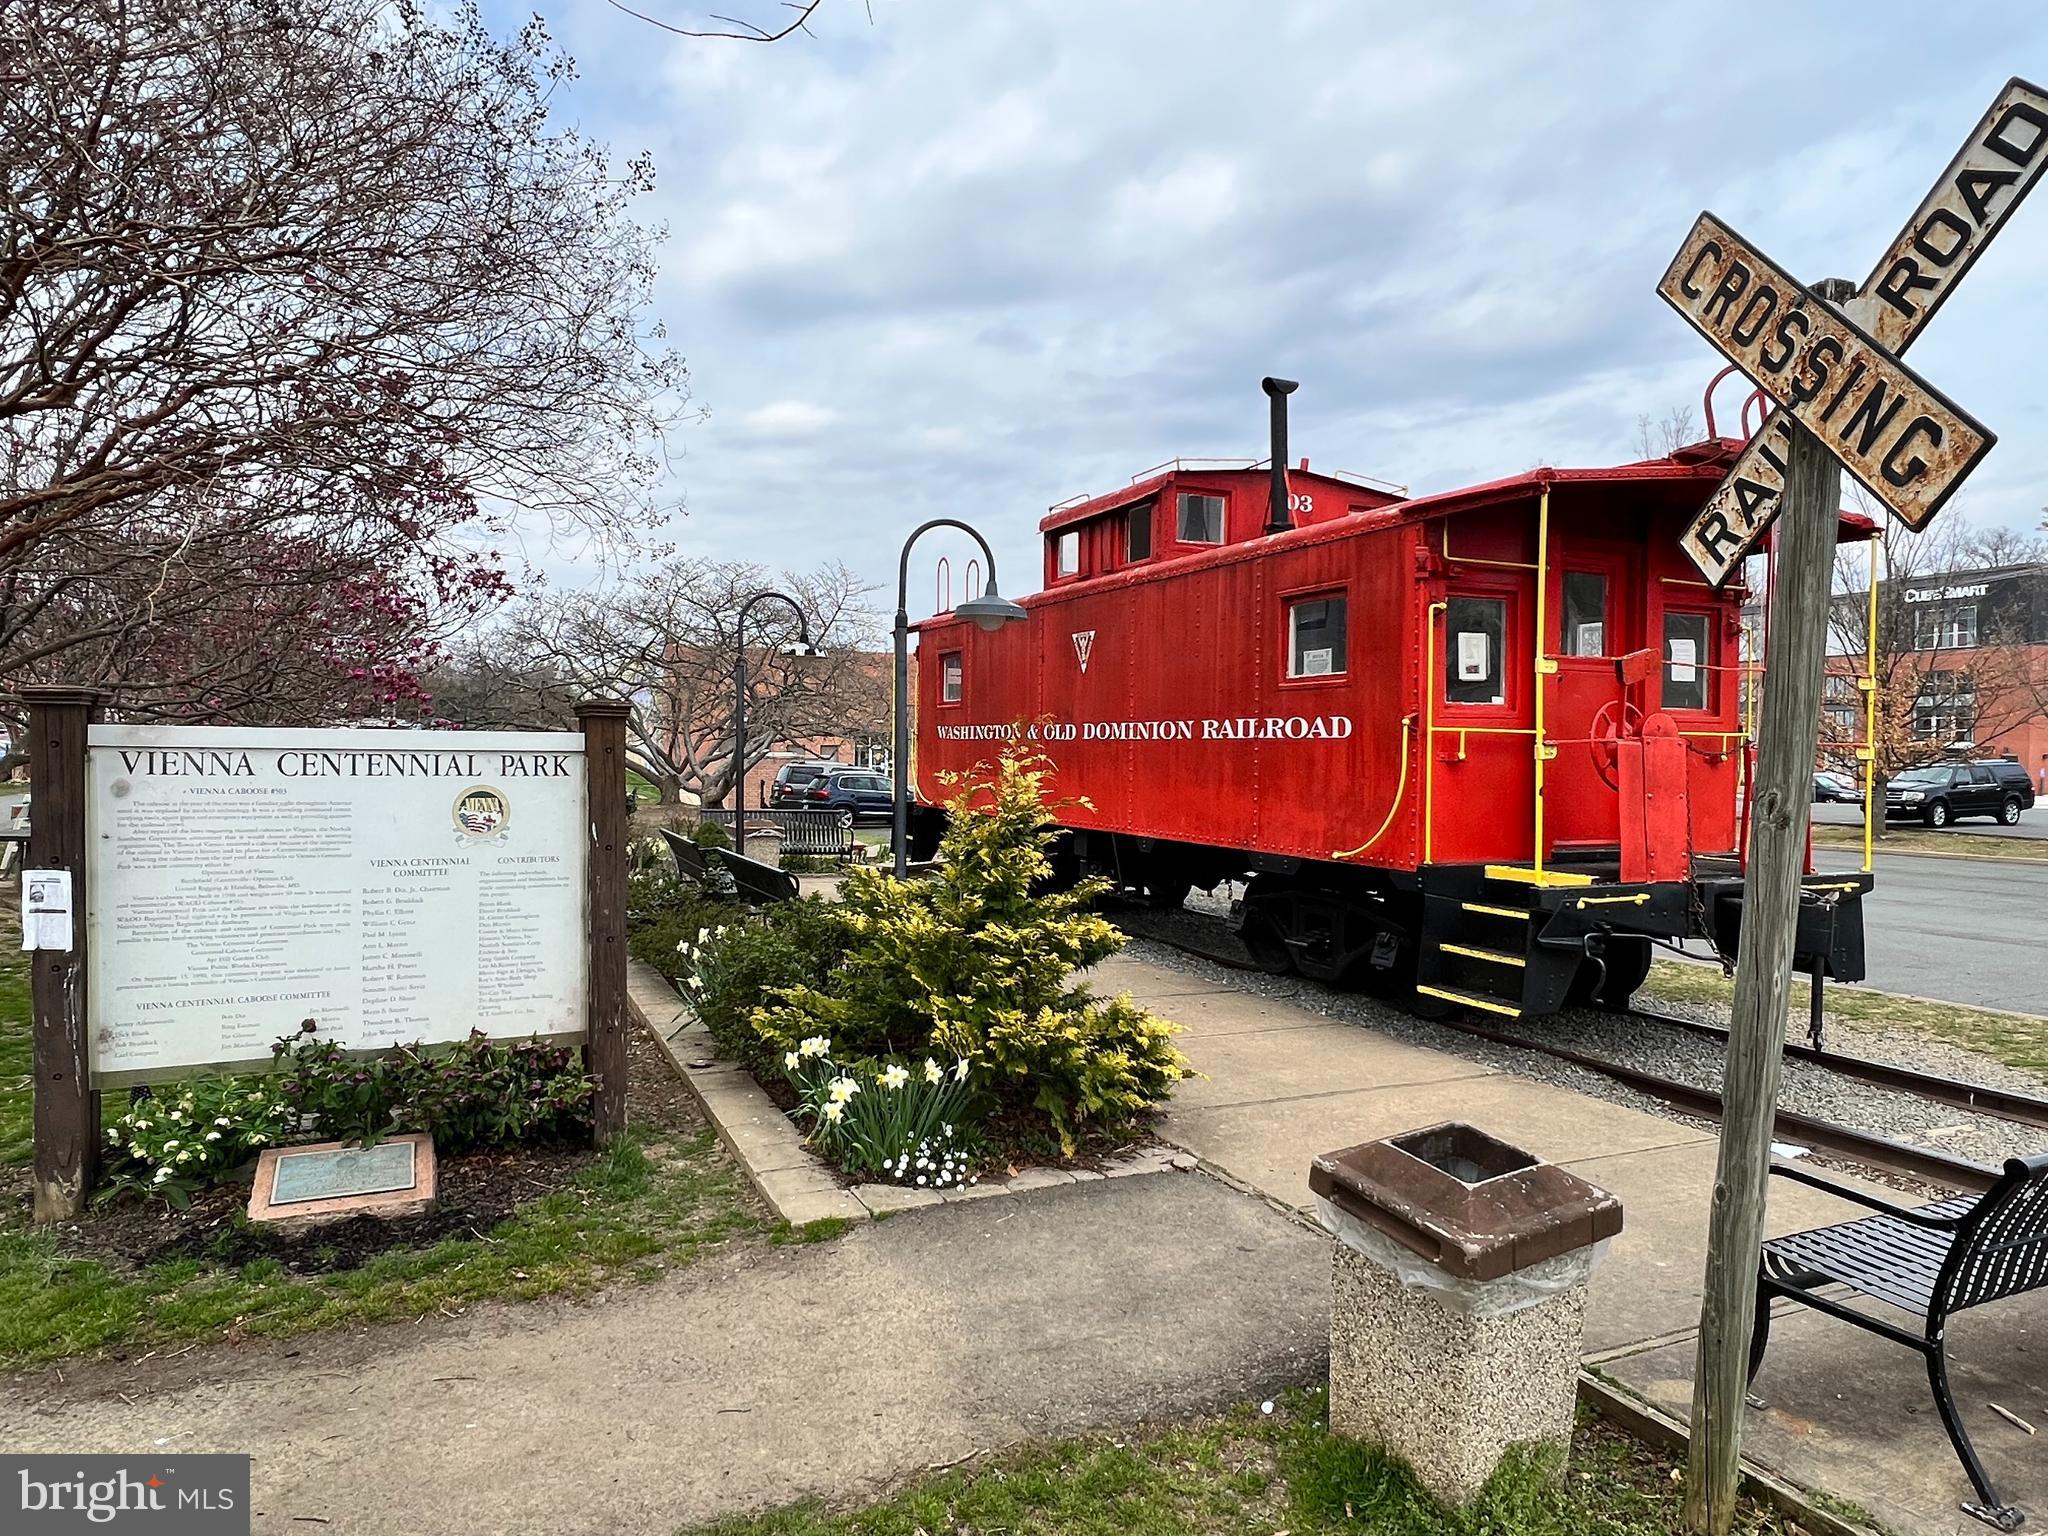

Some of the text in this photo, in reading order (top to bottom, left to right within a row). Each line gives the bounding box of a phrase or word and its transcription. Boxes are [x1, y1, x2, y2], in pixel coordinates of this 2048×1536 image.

[1875, 101, 2048, 319] ROAD
[1681, 240, 1944, 488] CROSSING
[937, 716, 1353, 741] WASHINGTON & OLD DOMINION RAILROAD
[118, 750, 571, 777] VIENNA CENTENNIAL PARK
[189, 787, 226, 795] VIENNA
[370, 857, 471, 867] VIENNA CENTENNIAL
[497, 856, 560, 865] CONTRIBUTORS
[393, 868, 449, 877] COMMITTEE
[136, 1002, 173, 1010] VIENNA
[175, 997, 235, 1007] CENTENNIAL
[279, 991, 331, 1001] COMMITTEE
